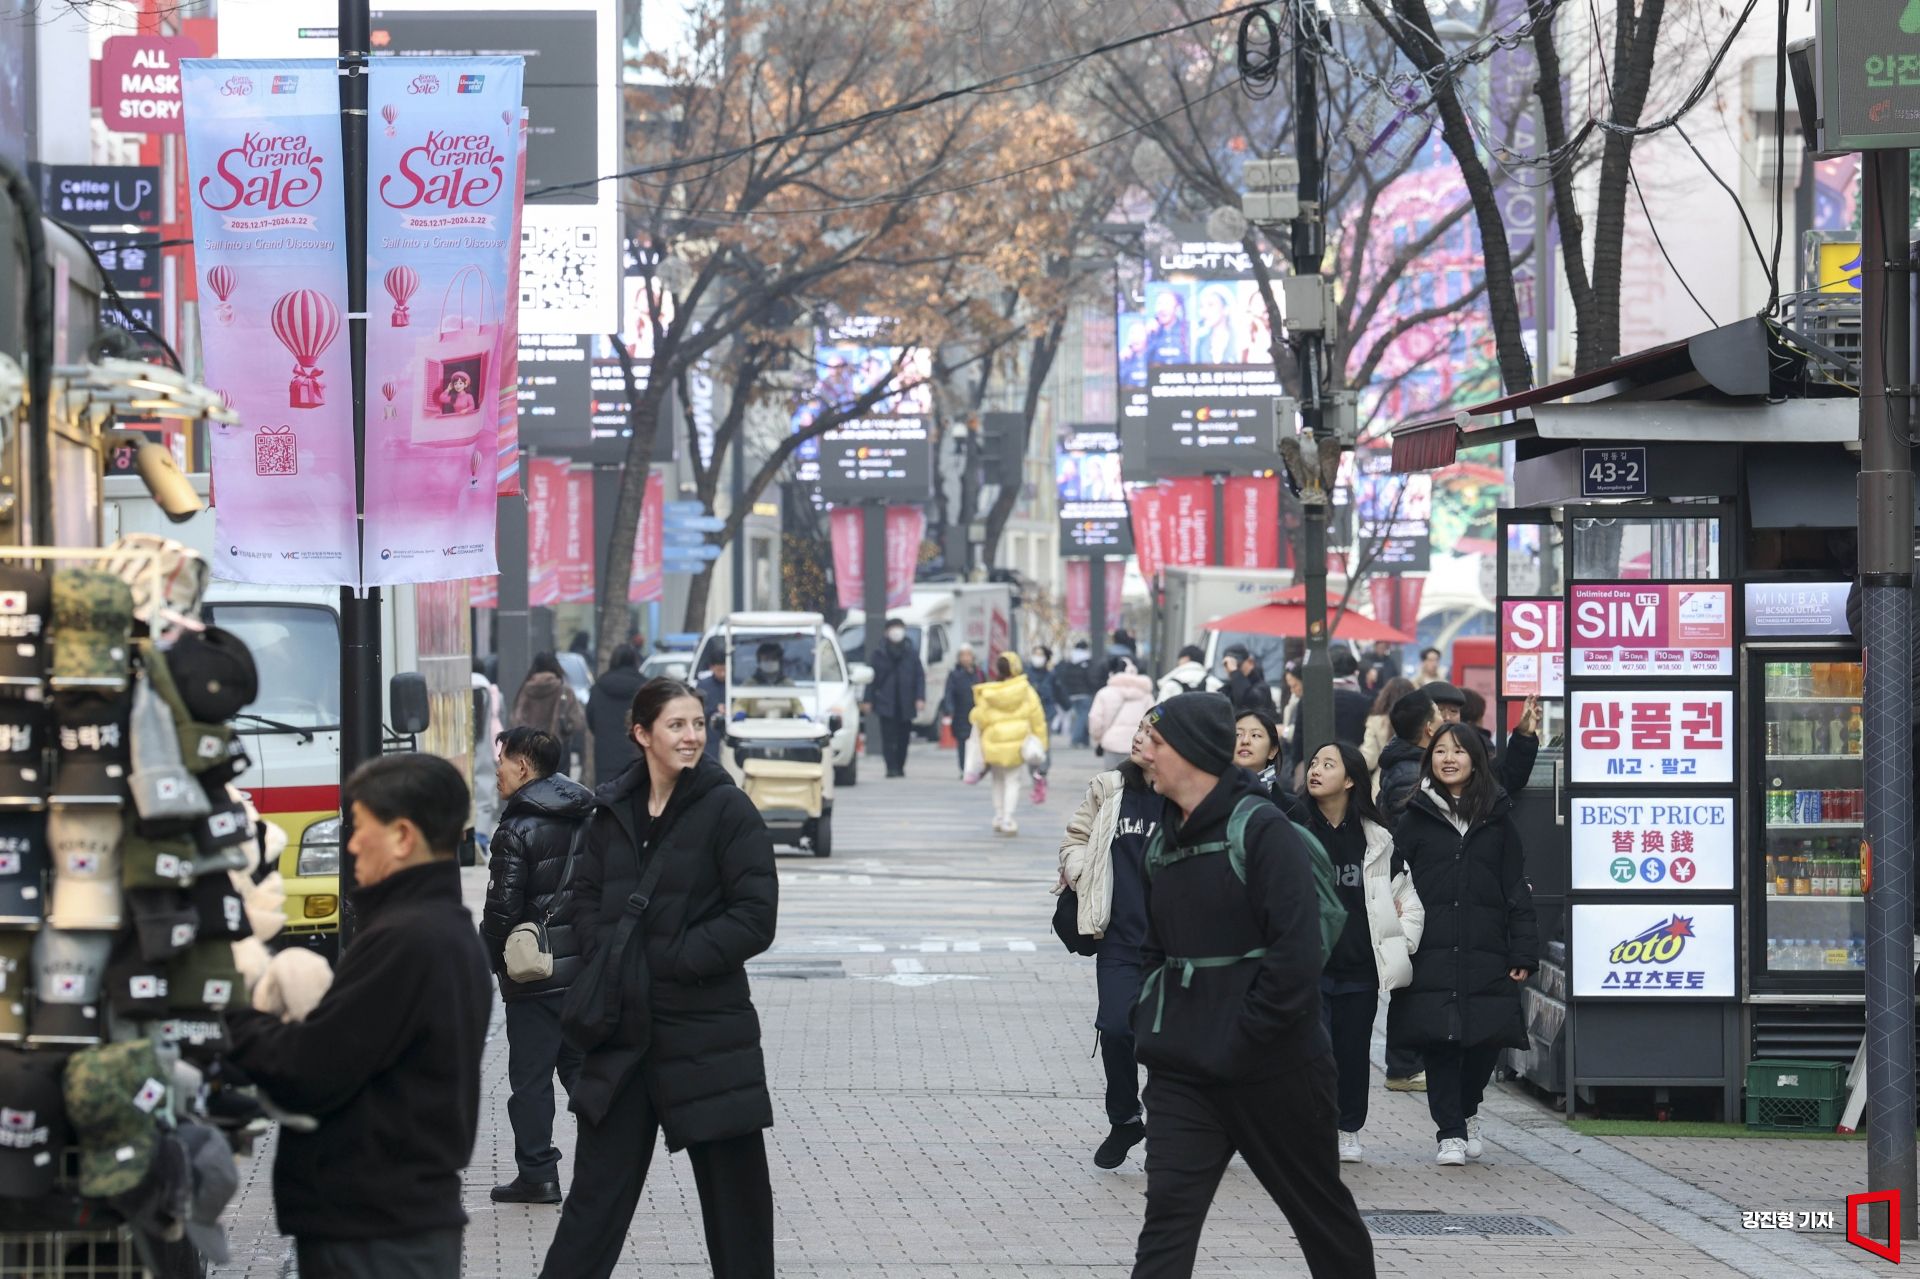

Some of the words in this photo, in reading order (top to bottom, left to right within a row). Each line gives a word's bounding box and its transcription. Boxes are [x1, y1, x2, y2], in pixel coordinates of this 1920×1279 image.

[132, 50, 170, 69] ALL
[121, 74, 180, 94] MASK
[407, 78, 440, 94] Sale
[119, 99, 182, 119] STORY
[242, 131, 307, 152] Korea
[426, 130, 490, 151] Korea
[248, 146, 312, 168] Grand
[430, 146, 495, 168] Grand
[61, 179, 110, 195] Coffee
[199, 148, 324, 211] Sale
[379, 146, 505, 210] Sale
[61, 198, 73, 212] &
[204, 238, 222, 250] Sail
[223, 239, 242, 250] into
[254, 238, 283, 250] Grand
[285, 238, 335, 252] Discovery
[382, 237, 400, 249] Sail
[402, 237, 420, 249] into
[433, 237, 462, 249] Grand
[1601, 451, 1627, 461] 명동길
[1589, 461, 1640, 483] 43-2
[1576, 590, 1612, 598] Unlimited
[1614, 590, 1631, 598] Data
[1638, 595, 1657, 604] LTE
[1755, 591, 1830, 605] MINIBAR
[1576, 601, 1656, 639] SIM
[1796, 606, 1821, 614] ULTRA
[1510, 602, 1564, 649] SI
[1579, 702, 1723, 750] 상품권
[1607, 758, 1642, 775] 사고
[1661, 758, 1696, 775] 팔고
[1581, 805, 1643, 826] BEST
[1651, 805, 1725, 826] PRICE
[1612, 830, 1694, 854] 替換錢
[1614, 861, 1632, 880] 元
[1609, 932, 1684, 964] toto
[1601, 970, 1705, 989] 스포츠토토
